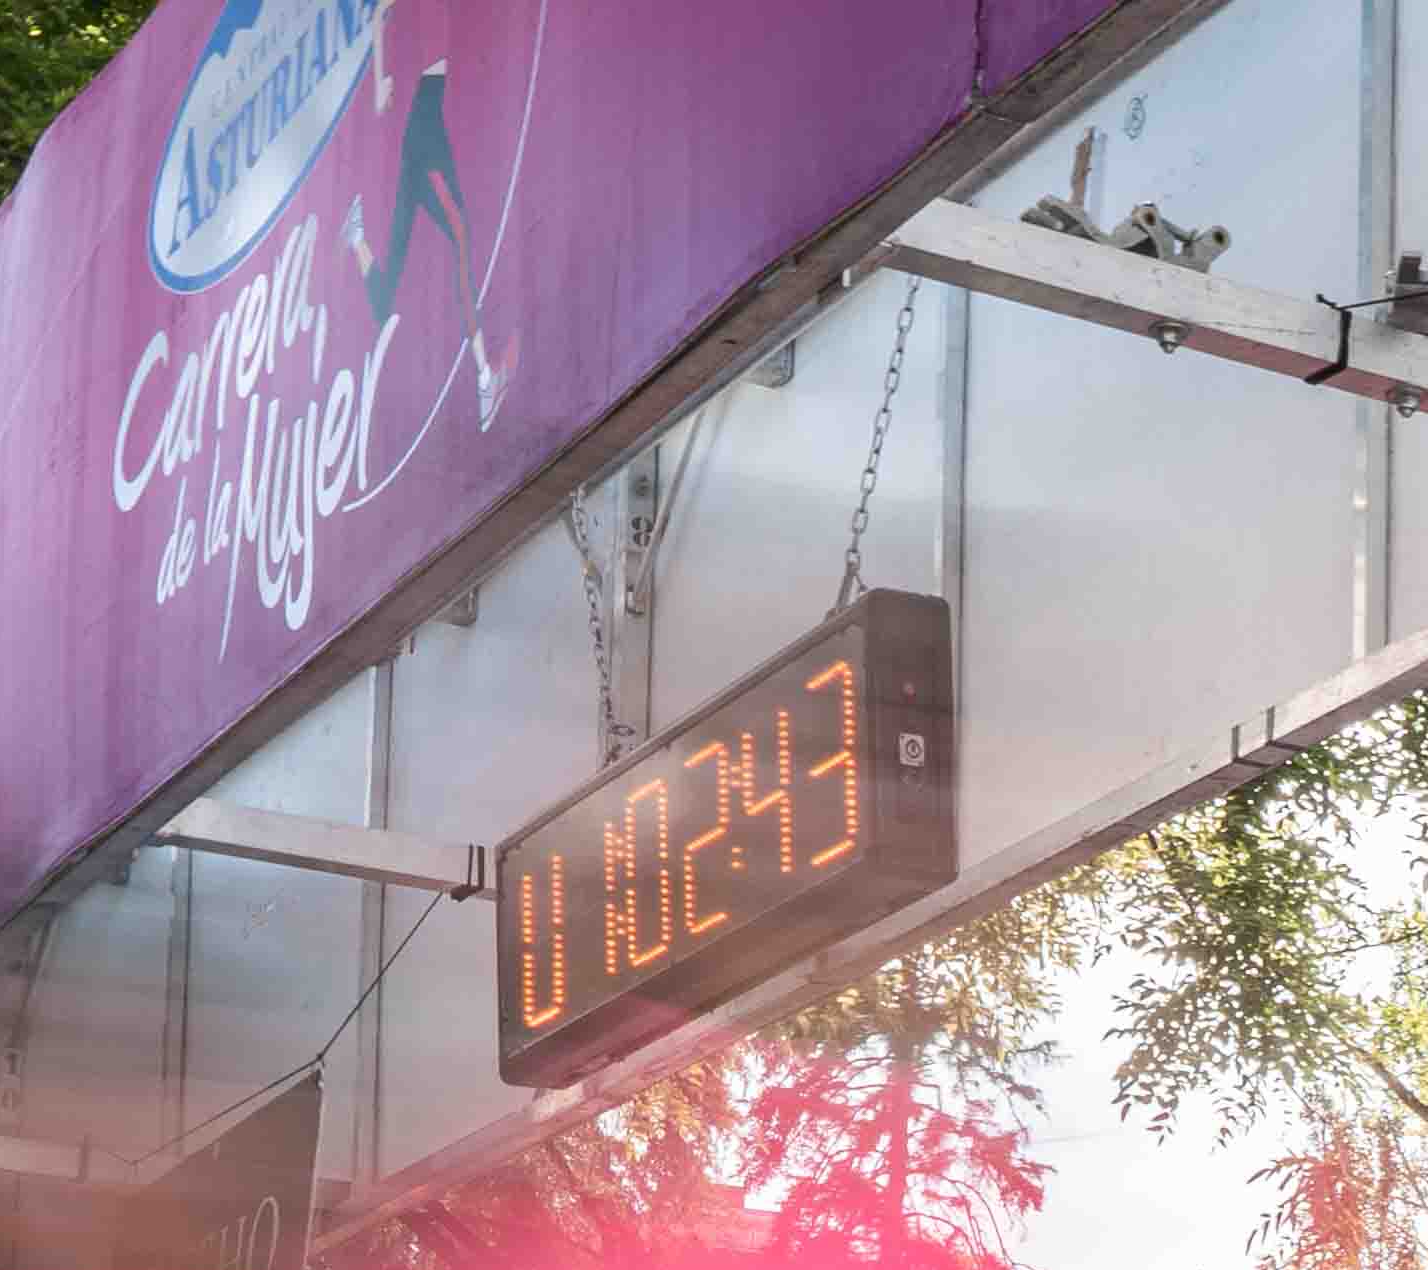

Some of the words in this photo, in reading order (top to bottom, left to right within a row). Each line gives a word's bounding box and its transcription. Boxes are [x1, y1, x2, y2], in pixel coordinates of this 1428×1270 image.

[157, 475, 197, 605] de
[204, 436, 232, 565] la
[218, 313, 401, 664] Mujer
